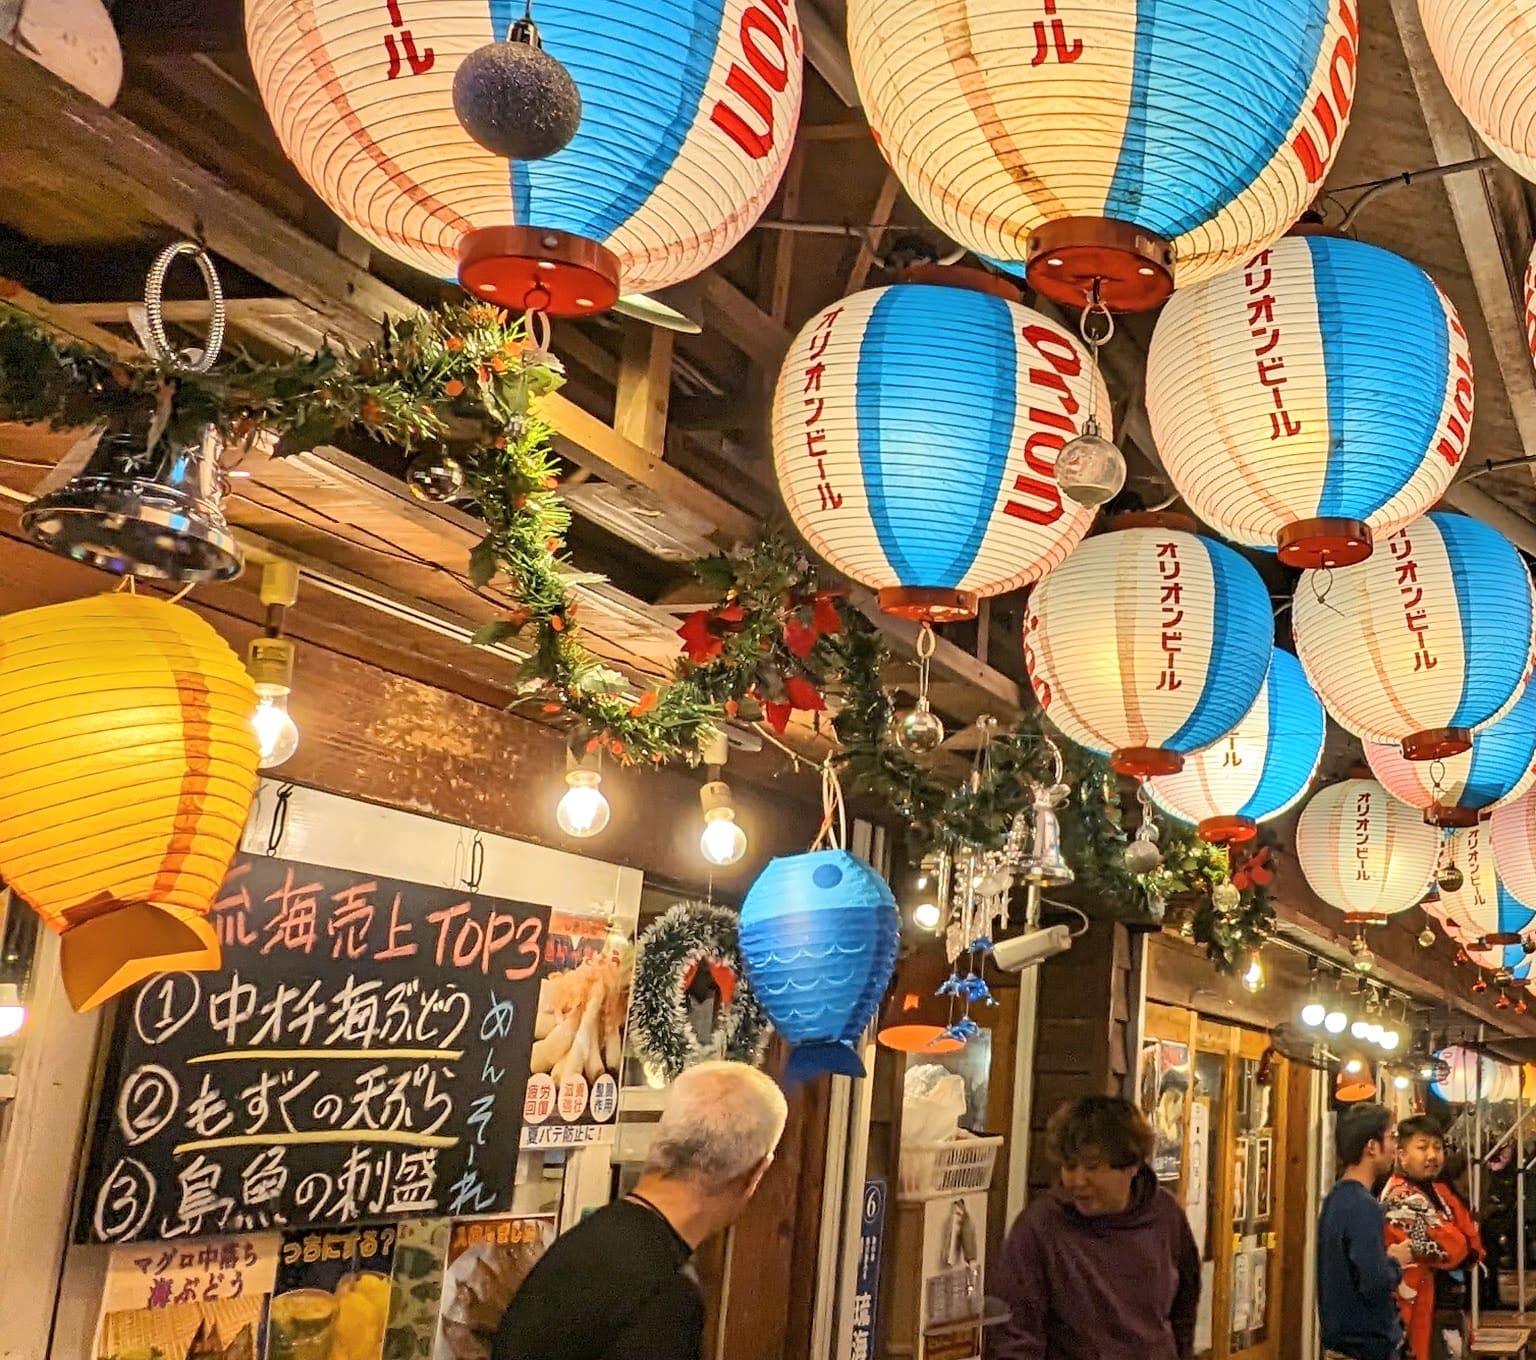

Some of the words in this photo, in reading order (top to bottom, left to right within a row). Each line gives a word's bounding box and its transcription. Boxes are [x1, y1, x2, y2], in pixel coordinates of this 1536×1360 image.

[805, 310, 842, 510] オリオンビール
[1158, 544, 1181, 690] オリオンビール
[1355, 792, 1372, 881] オリオンビール
[1467, 829, 1486, 906] オリオンビール
[449, 990, 513, 1212] めんそーれ
[133, 1242, 259, 1276] マグロ中落ち
